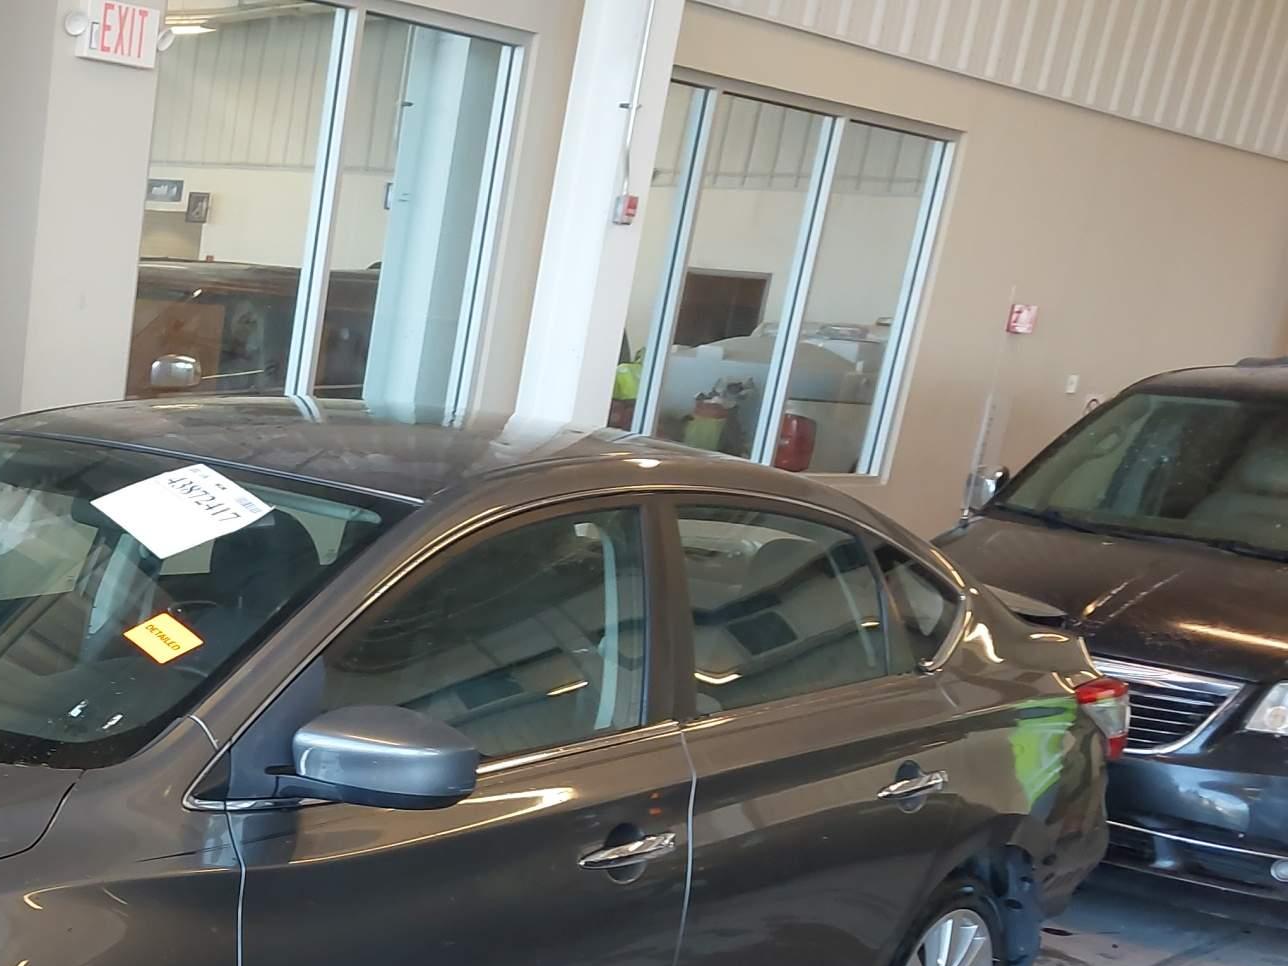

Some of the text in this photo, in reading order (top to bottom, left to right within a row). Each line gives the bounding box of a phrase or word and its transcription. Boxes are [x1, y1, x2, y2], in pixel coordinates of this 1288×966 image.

[100, 2, 149, 59] EXIT
[167, 476, 241, 522] 43872417
[145, 624, 181, 651] DETAILED
